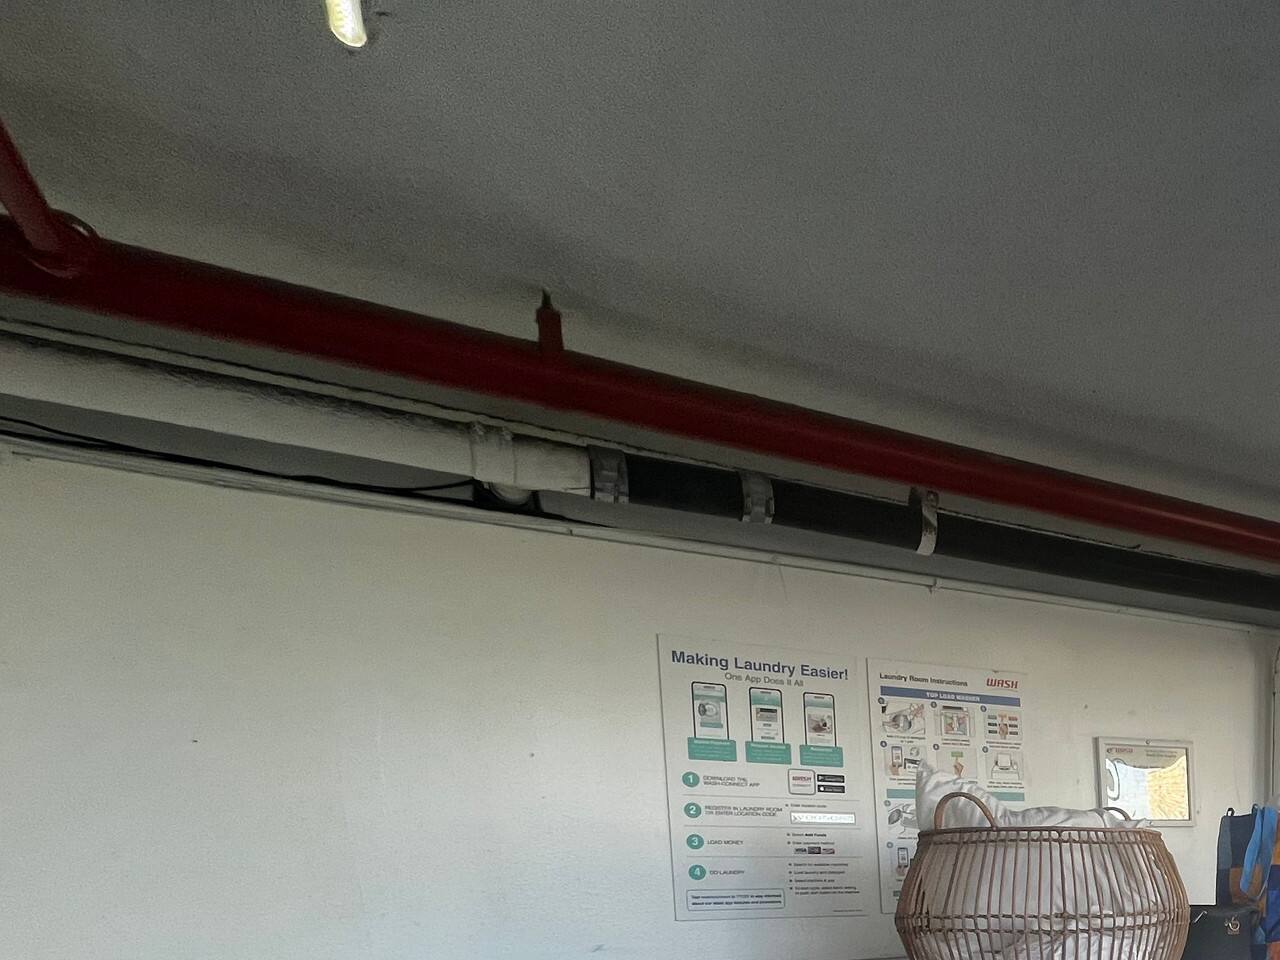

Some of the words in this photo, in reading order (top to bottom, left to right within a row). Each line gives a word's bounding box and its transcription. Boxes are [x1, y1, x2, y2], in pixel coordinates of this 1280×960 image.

[672, 650, 729, 670] Making
[734, 657, 796, 677] Laundry
[801, 664, 848, 681] Easier!
[725, 672, 743, 682] One
[745, 674, 761, 684] App
[764, 675, 784, 685] Does
[794, 679, 804, 687] All
[879, 672, 908, 682] Laundry
[909, 675, 929, 683] Room
[930, 677, 968, 687] Instructions
[986, 677, 1019, 689] WASH
